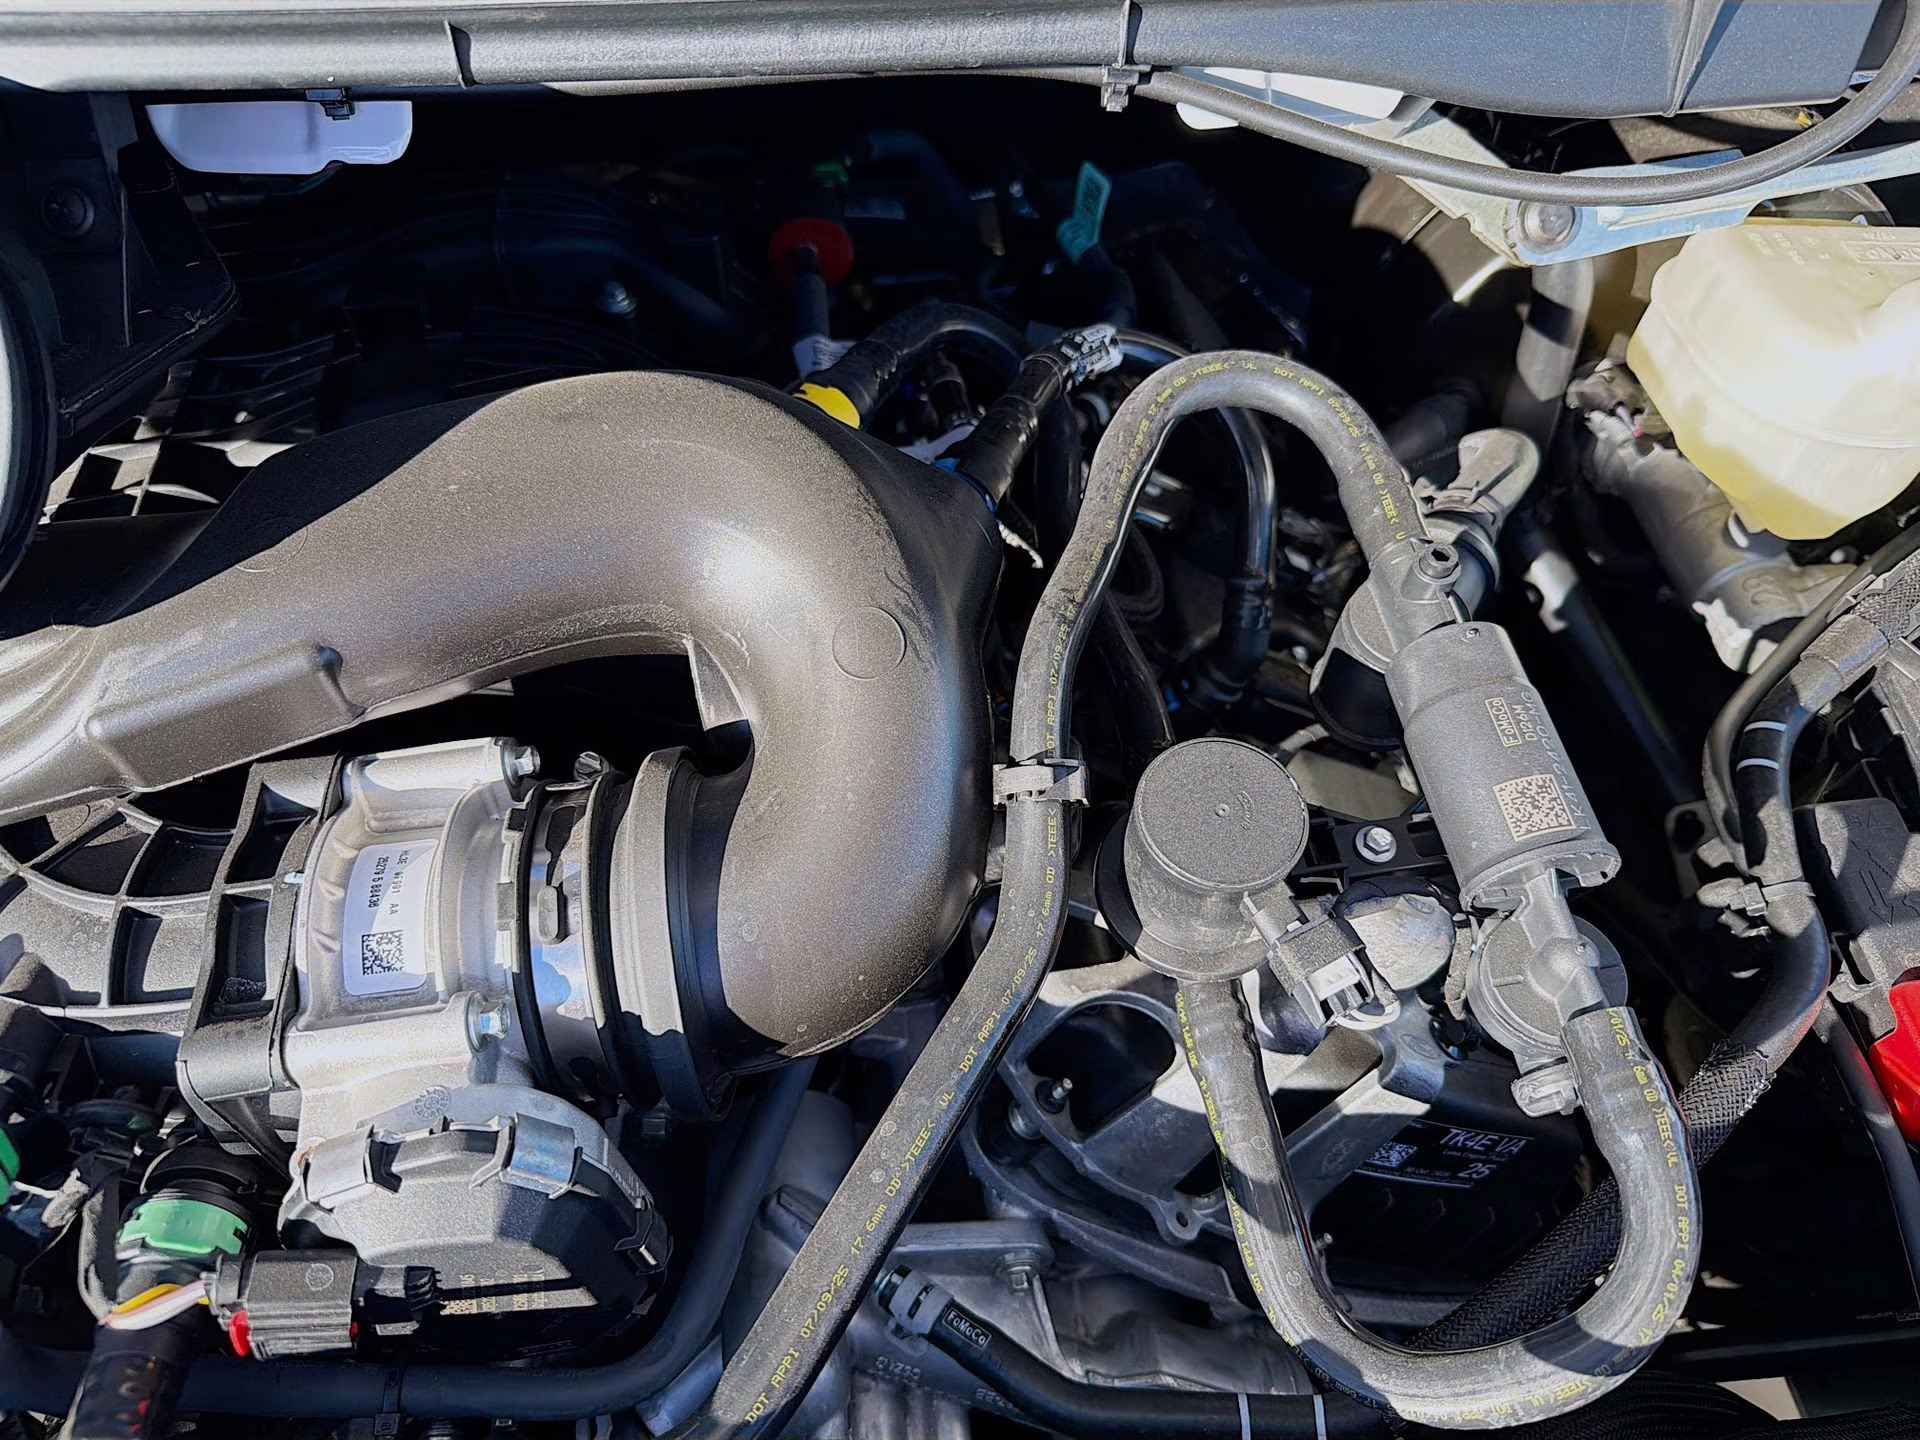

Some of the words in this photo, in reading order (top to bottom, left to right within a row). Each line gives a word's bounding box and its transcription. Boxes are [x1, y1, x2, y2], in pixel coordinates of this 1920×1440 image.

[1273, 367, 1296, 379] DOT
[1299, 378, 1324, 395] APPI
[1328, 398, 1361, 437] 07/09/25
[1049, 623, 1069, 685] 07/09/25
[1047, 693, 1057, 726] APPI
[1492, 699, 1519, 744] FoMoCo
[1512, 704, 1538, 741] D126M
[389, 903, 399, 915] AA
[1440, 1128, 1495, 1150] TK4E
[1495, 1137, 1526, 1154] VA
[1458, 1162, 1497, 1179] 25
[1666, 1151, 1680, 1168] UL
[744, 1392, 770, 1424] DOT
[770, 1347, 800, 1389] APPI
[800, 1264, 849, 1339] 07/09/25
[939, 1090, 955, 1109] UL
[959, 1045, 979, 1073] DOT
[977, 1010, 1001, 1042] APPI
[1001, 946, 1038, 1005] 07/09/25
[1674, 1184, 1689, 1210] DOT
[1677, 1216, 1690, 1250] APPI
[1251, 1272, 1264, 1294] DOT
[1652, 1259, 1686, 1323] 04/01/25
[947, 1311, 987, 1345] FoMoCo
